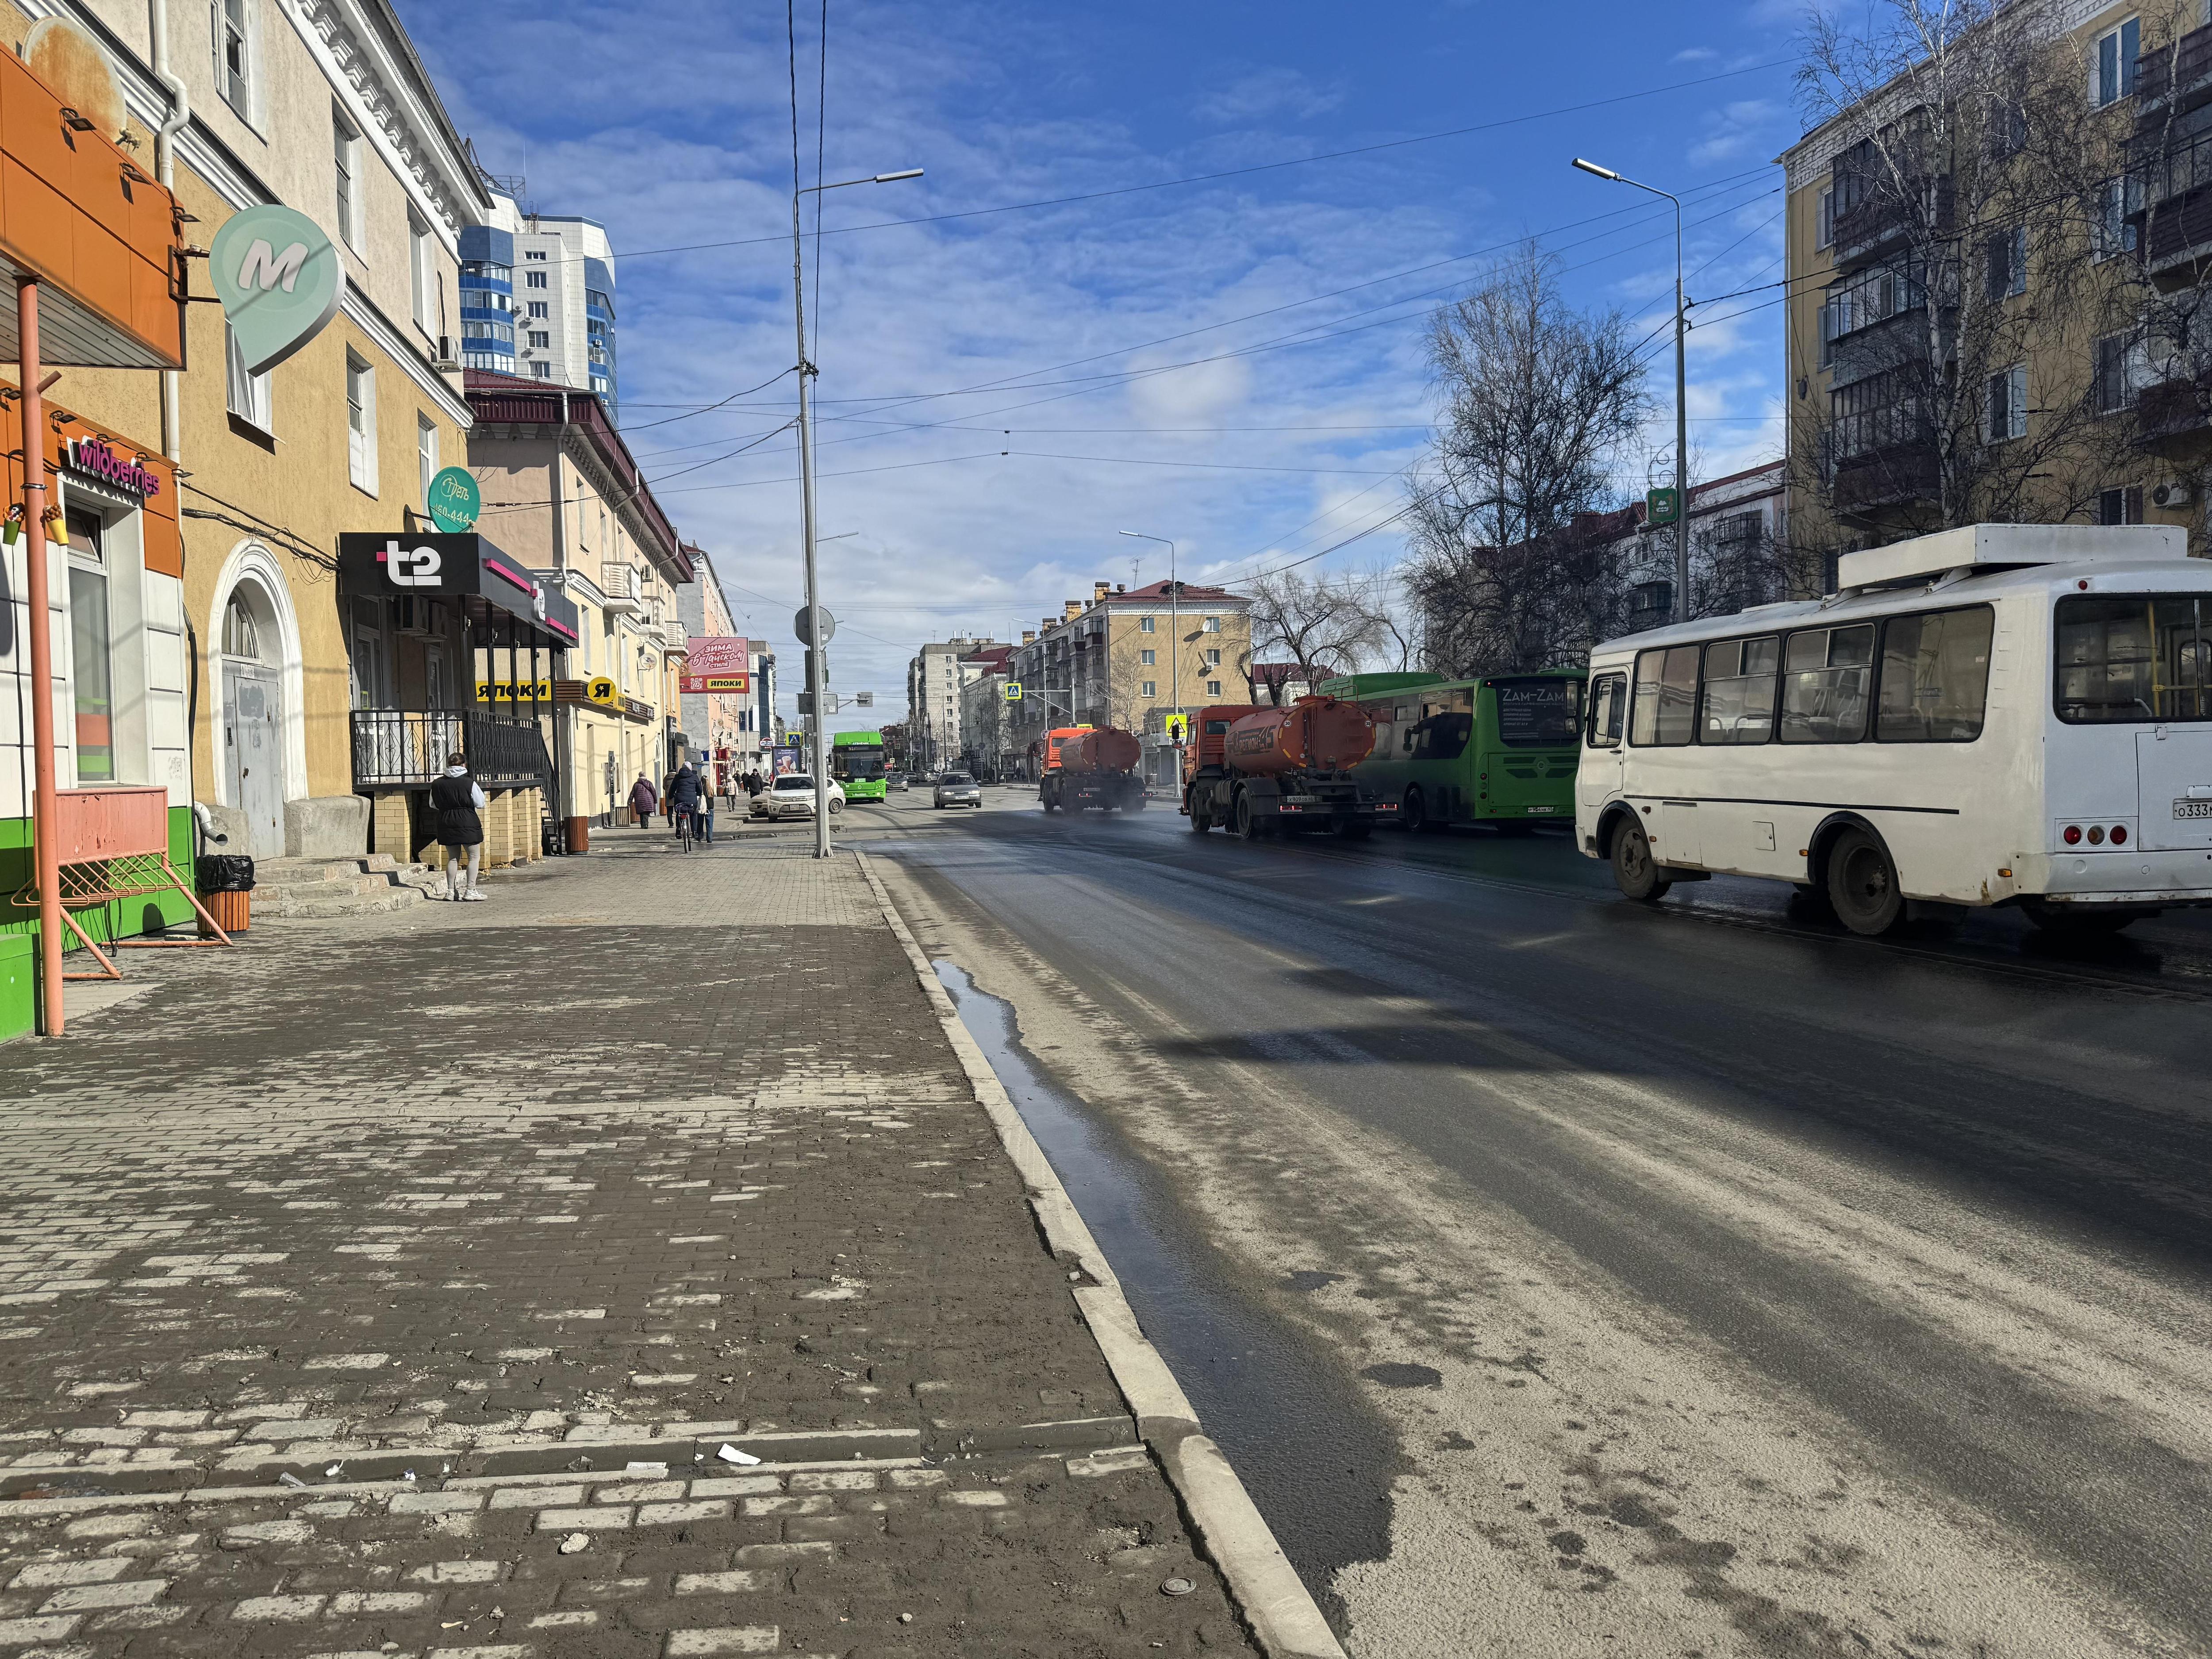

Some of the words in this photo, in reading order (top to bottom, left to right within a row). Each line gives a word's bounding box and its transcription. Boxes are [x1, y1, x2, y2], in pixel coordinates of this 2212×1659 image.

[79, 439, 160, 495] wildberries
[376, 541, 442, 586] t2
[704, 643, 733, 653] ЗИМА
[690, 653, 701, 665] в
[477, 684, 547, 697] ЯПОКИ
[593, 683, 611, 697] Я
